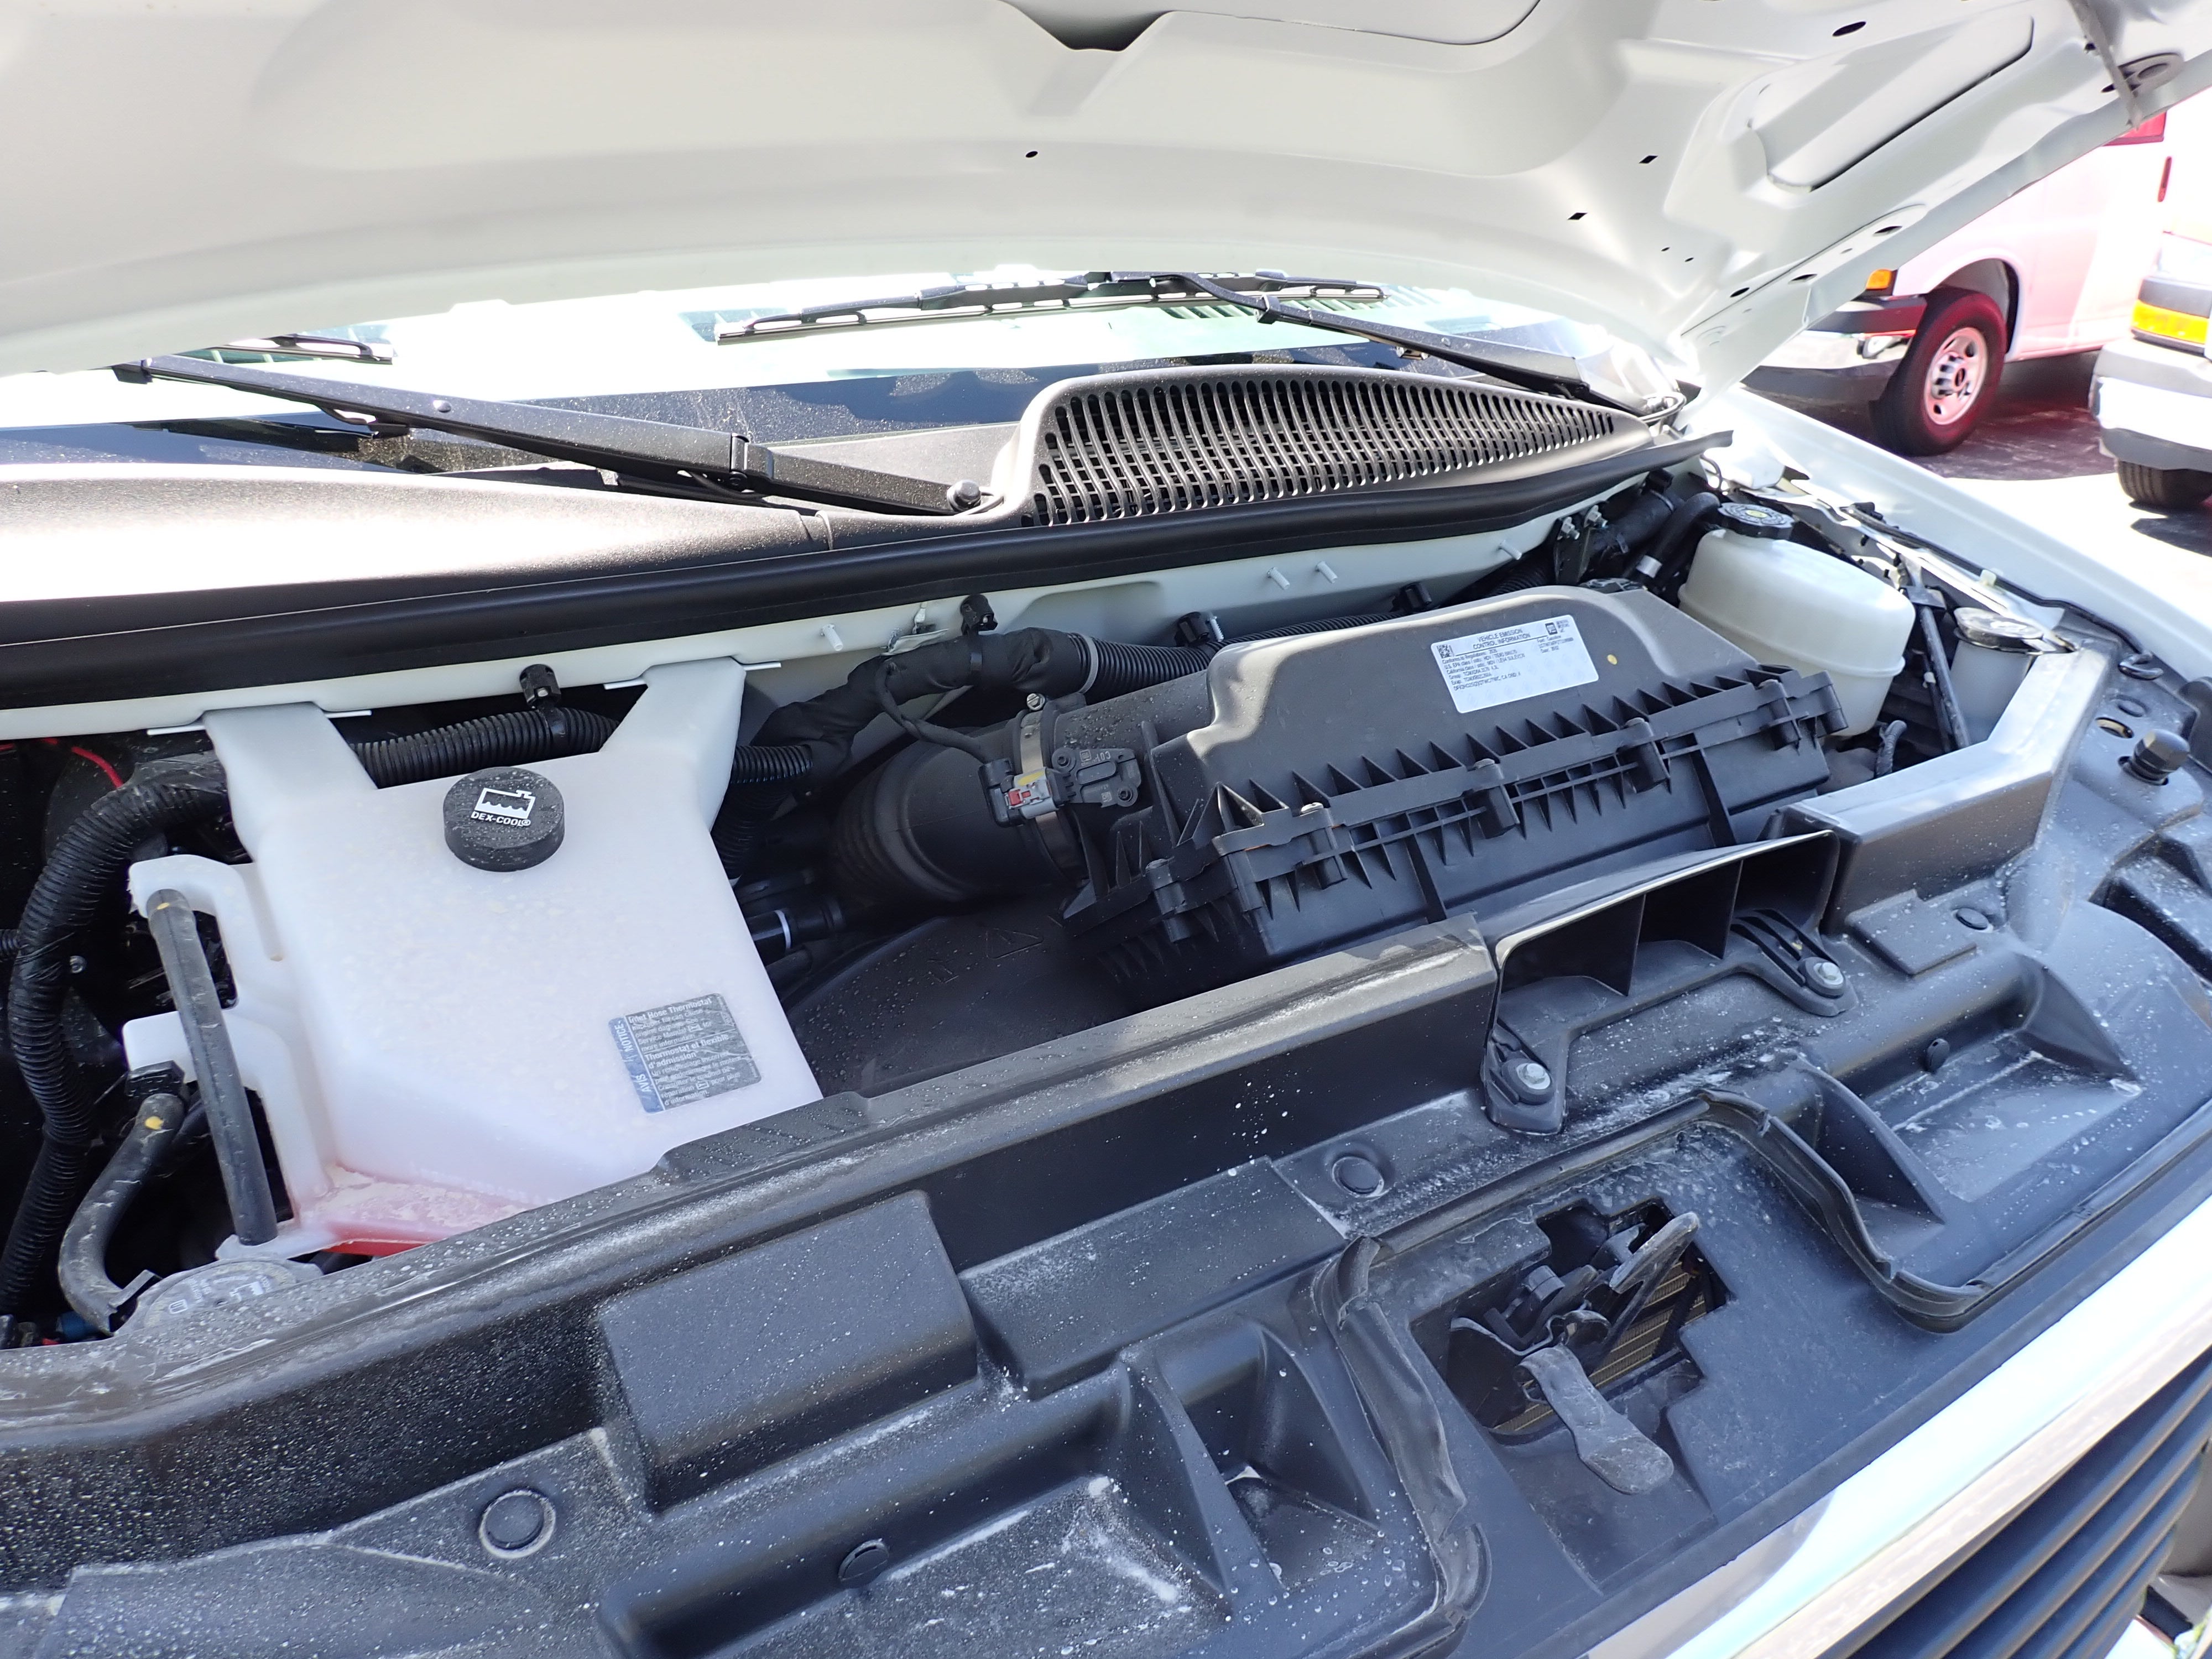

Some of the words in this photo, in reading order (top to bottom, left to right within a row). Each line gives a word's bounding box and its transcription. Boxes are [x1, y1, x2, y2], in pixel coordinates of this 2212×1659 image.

[1472, 640, 1498, 649] CONTROL
[1496, 633, 1531, 644] INFORMATION
[1477, 633, 1499, 642] VEHICLE
[1498, 628, 1523, 638] EMISSION
[646, 1009, 667, 1019] Hose
[667, 998, 713, 1014] Thermostat
[613, 1023, 634, 1052] NOTICE
[637, 1034, 662, 1045] Service
[640, 1043, 658, 1051] more
[644, 1044, 691, 1061] Thermostat
[700, 1033, 730, 1046] flexible
[648, 1052, 697, 1069] d'admission
[635, 1073, 652, 1093] AVIS
